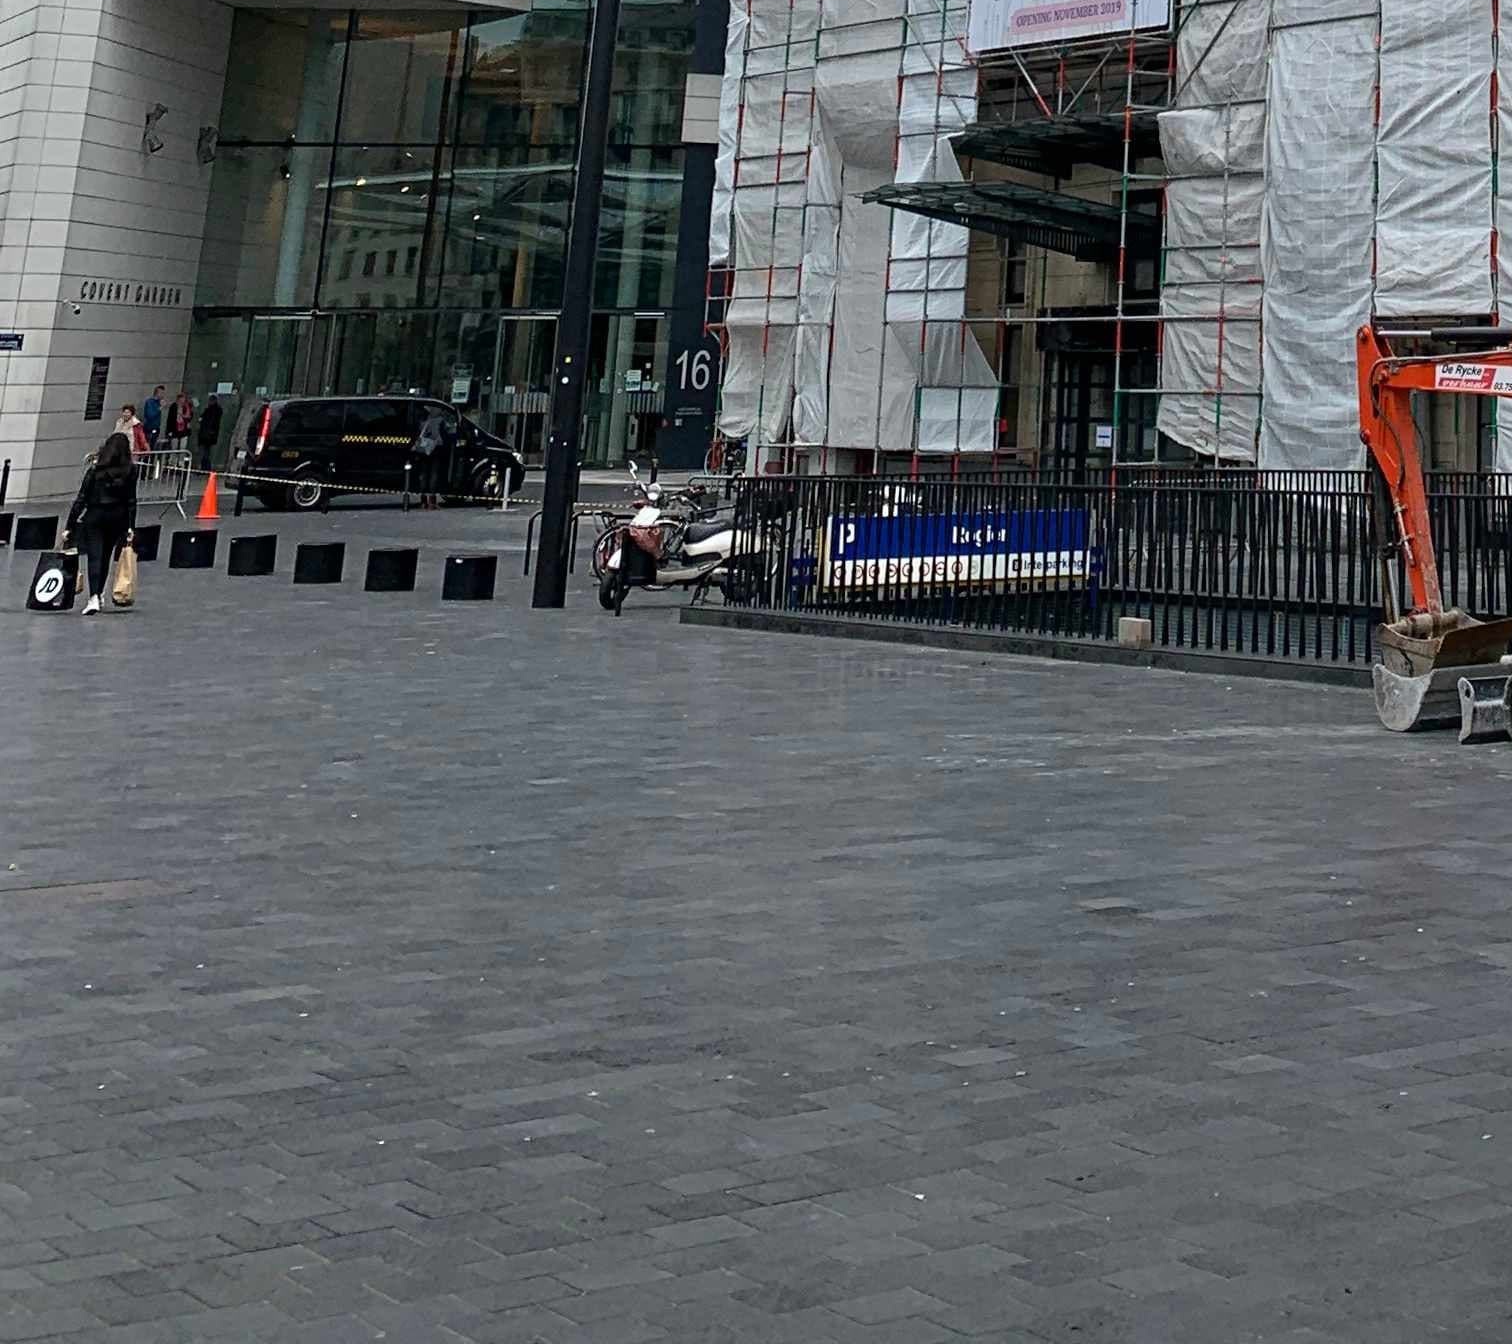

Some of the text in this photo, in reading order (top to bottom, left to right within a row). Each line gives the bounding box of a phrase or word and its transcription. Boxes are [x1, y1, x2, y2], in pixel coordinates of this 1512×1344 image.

[1016, 11, 1053, 28] OPENING
[1053, 3, 1099, 22] NOVEMBER
[80, 280, 183, 306] COVENT GARDEN
[676, 349, 711, 390] 16
[1441, 363, 1482, 378] De Rycke
